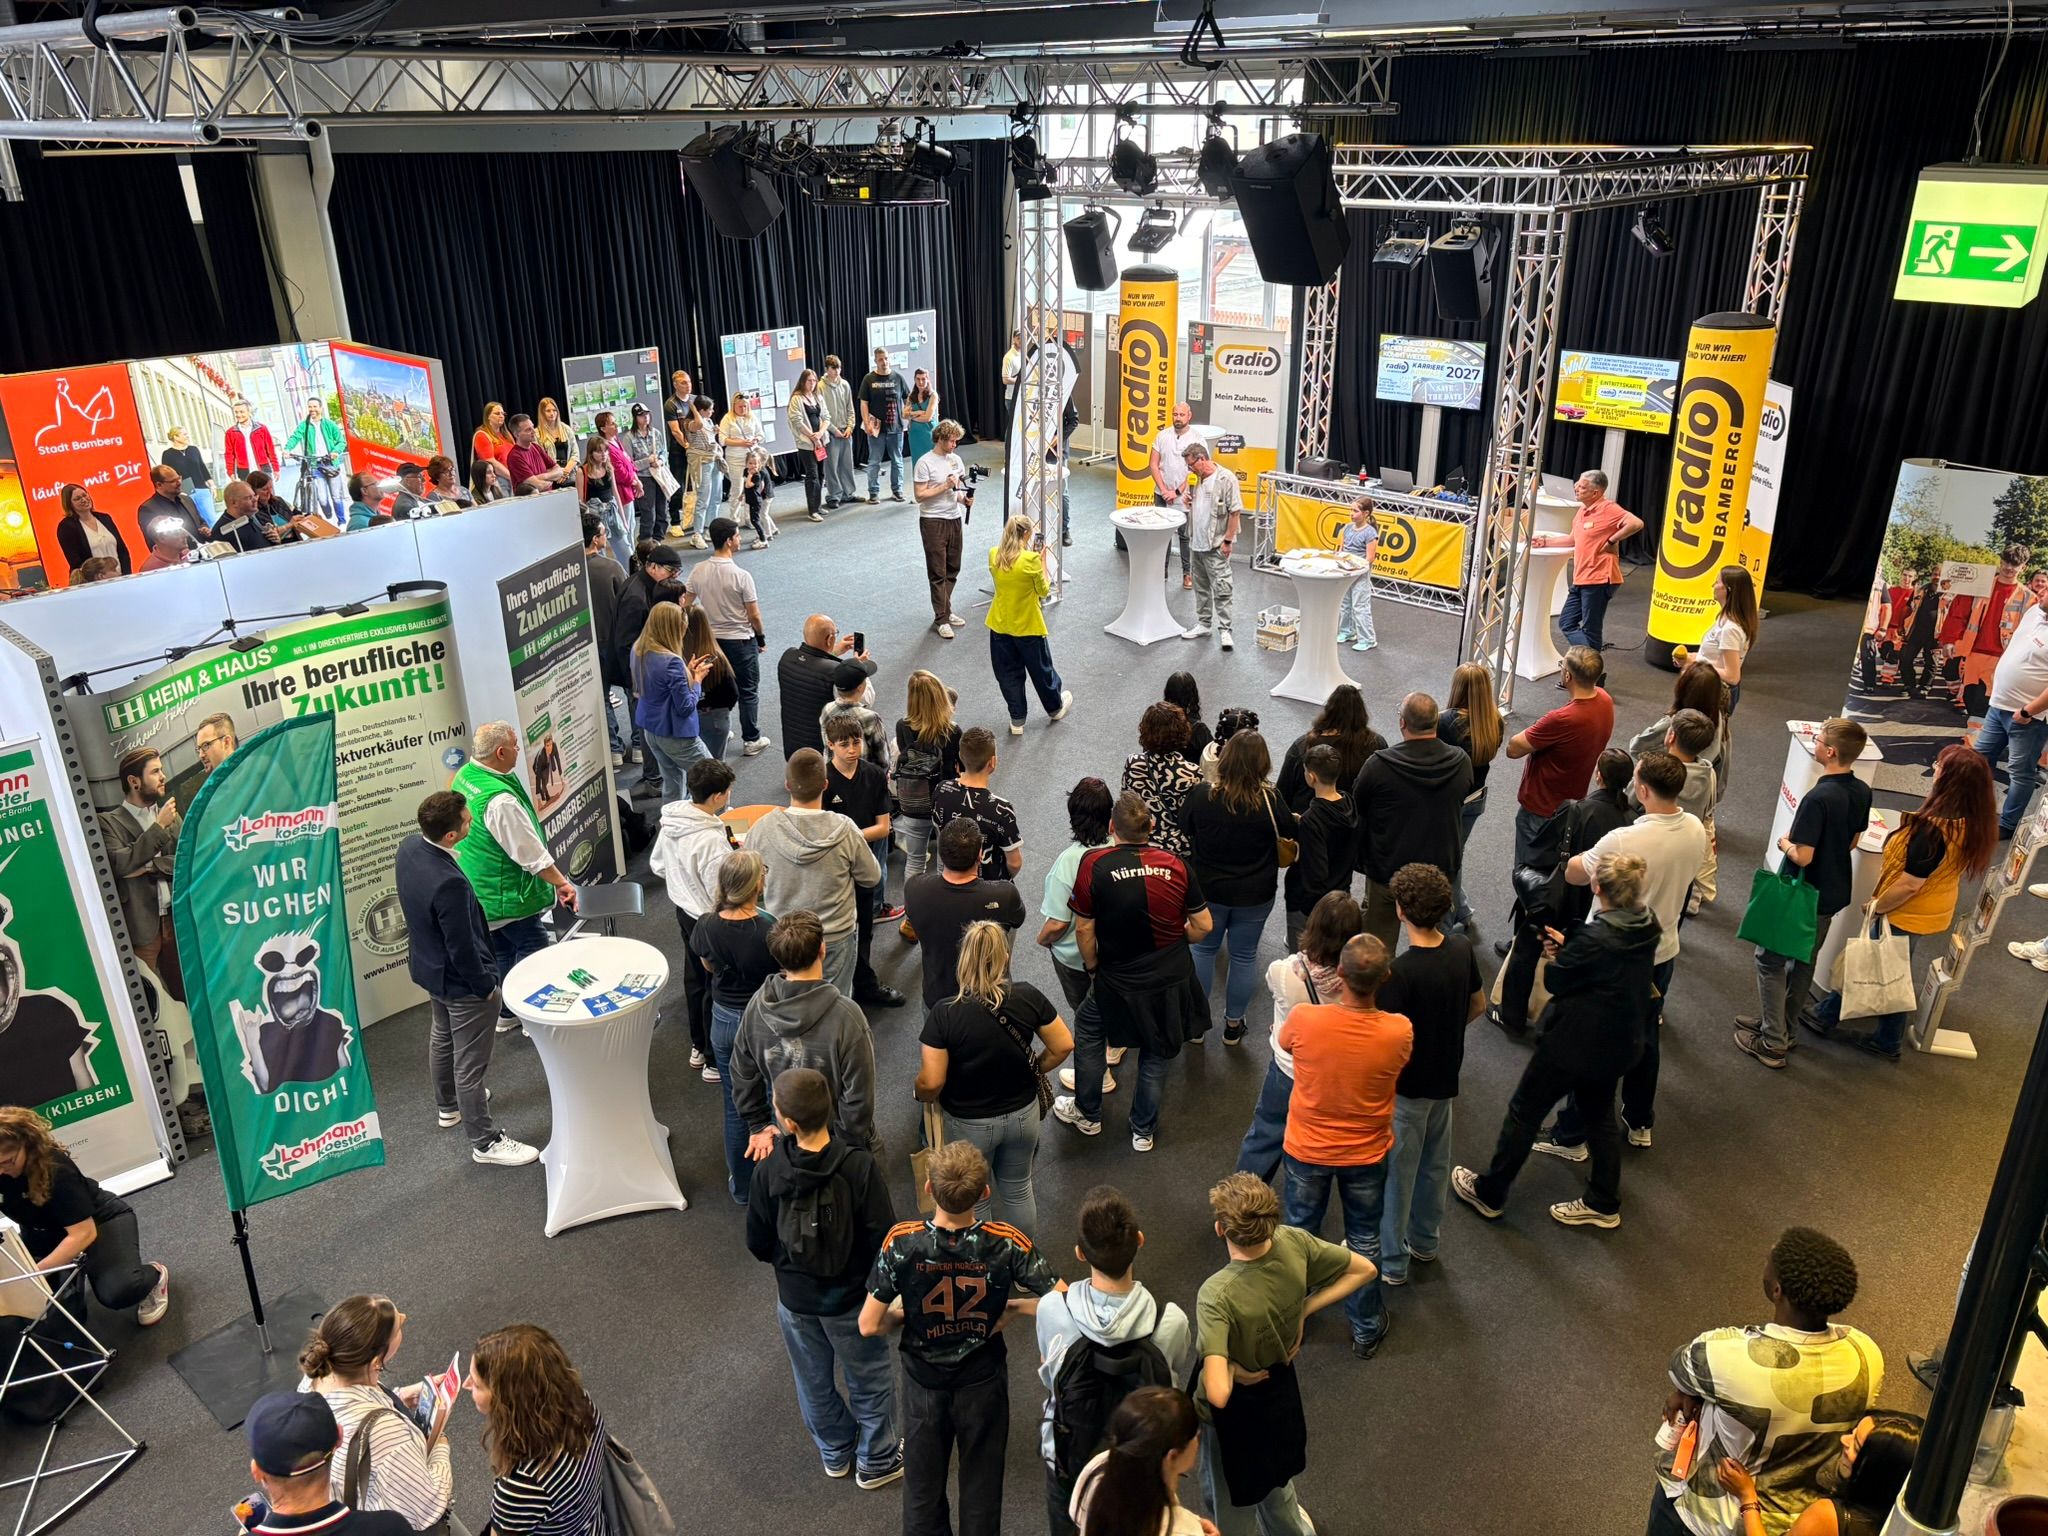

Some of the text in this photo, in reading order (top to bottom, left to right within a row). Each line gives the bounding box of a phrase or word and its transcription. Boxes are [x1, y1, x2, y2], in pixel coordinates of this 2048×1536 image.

[1225, 352, 1273, 367] radio
[1695, 343, 1732, 352] NUR WIR
[1700, 353, 1746, 362] VON HIER!
[1228, 368, 1263, 376] BAMBERG
[1412, 362, 1445, 371] KARRIERE
[1446, 366, 1480, 380] 2027
[1123, 339, 1151, 454] radio
[1157, 361, 1168, 431] AMBERG
[1215, 393, 1269, 402] Mein Zuhause.
[1233, 404, 1275, 414] Meine Hits.
[38, 436, 123, 455] Stadt Bamberg
[84, 472, 110, 487] mit
[114, 461, 142, 478] Dir
[1672, 402, 1718, 547] radio
[1713, 432, 1742, 537] BAMBERG
[506, 562, 581, 611] Ihre berufliche
[516, 584, 578, 637] Zukunft
[1671, 605, 1704, 614] ZEITEN!
[308, 642, 317, 653] IM
[318, 631, 369, 649] DIREKTVERTRIEB
[369, 623, 407, 637] EXKLUSIVER
[408, 614, 448, 631] BAUELEMENTE
[242, 640, 446, 710] Ihre berufliche
[149, 676, 194, 710] HEIM
[199, 670, 212, 687] &
[291, 663, 446, 717] Zukunft!
[347, 728, 362, 737] uns,
[362, 716, 407, 732] Deutschlands
[383, 729, 393, 738] als
[429, 721, 467, 745] (m/w)
[368, 757, 393, 770] Zukunft
[377, 767, 383, 776] in
[9, 803, 32, 816] Brand
[544, 775, 604, 841] KARRIERESTART
[241, 808, 324, 834] Lohmann
[275, 821, 323, 839] koester
[341, 820, 368, 835] bieten:
[252, 857, 307, 888] WIR
[1111, 865, 1172, 882] Nürnberg
[222, 882, 331, 925] SUCHEN
[46, 1084, 122, 1119] (K)LEBEN!
[274, 1076, 349, 1113] DICH!
[280, 1120, 366, 1162] Lohmann
[317, 1131, 367, 1158] koester
[916, 1263, 925, 1272] FC
[922, 1276, 988, 1321] 42
[926, 1321, 987, 1340] MUSIALA
